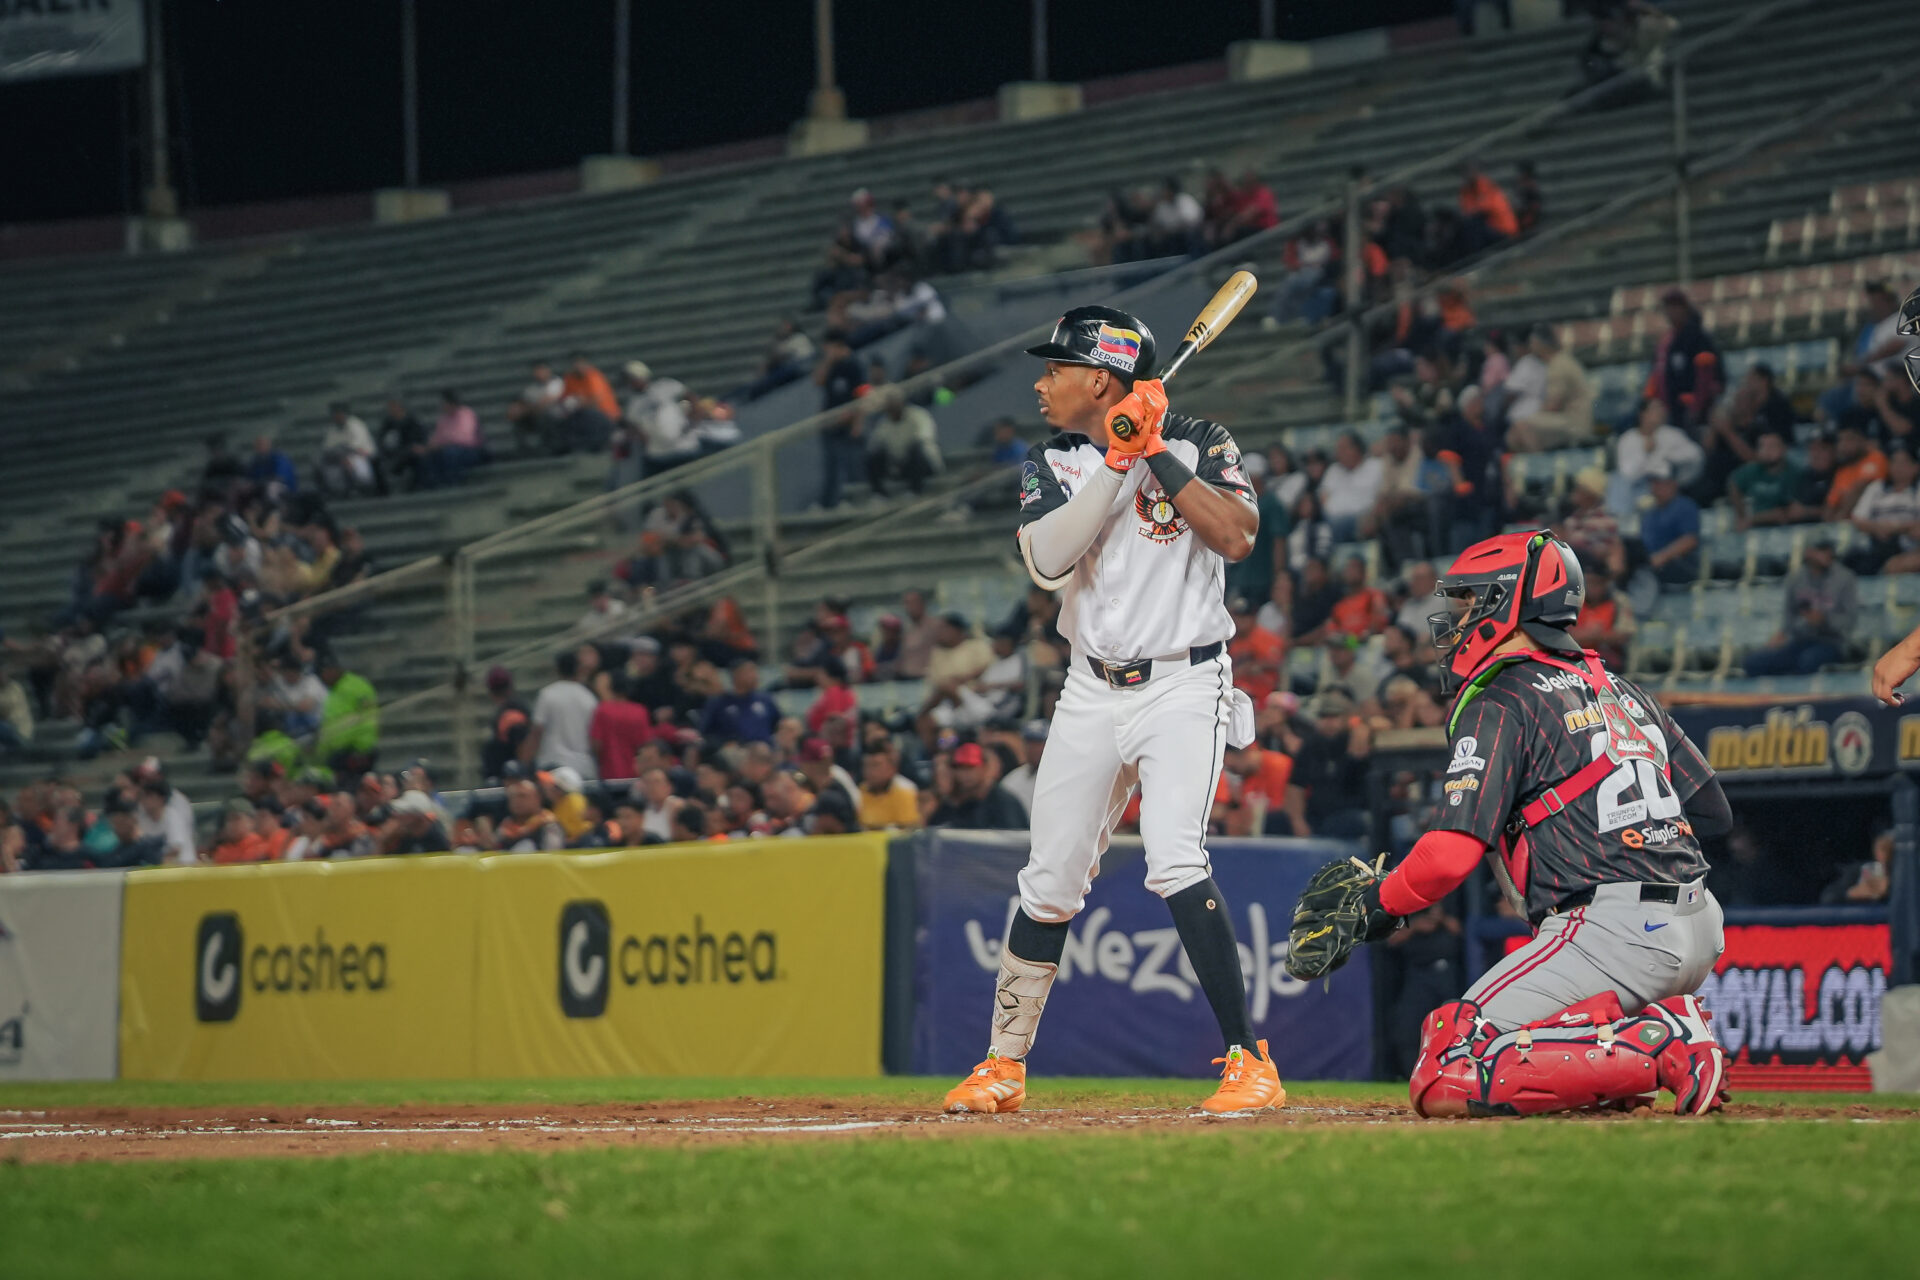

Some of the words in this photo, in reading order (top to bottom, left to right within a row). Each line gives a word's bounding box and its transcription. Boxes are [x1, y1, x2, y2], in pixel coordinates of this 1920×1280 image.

[1091, 349, 1134, 371] DEPORTE
[1591, 724, 1681, 834] 20
[250, 926, 387, 993] cashea
[619, 913, 776, 985] cashea
